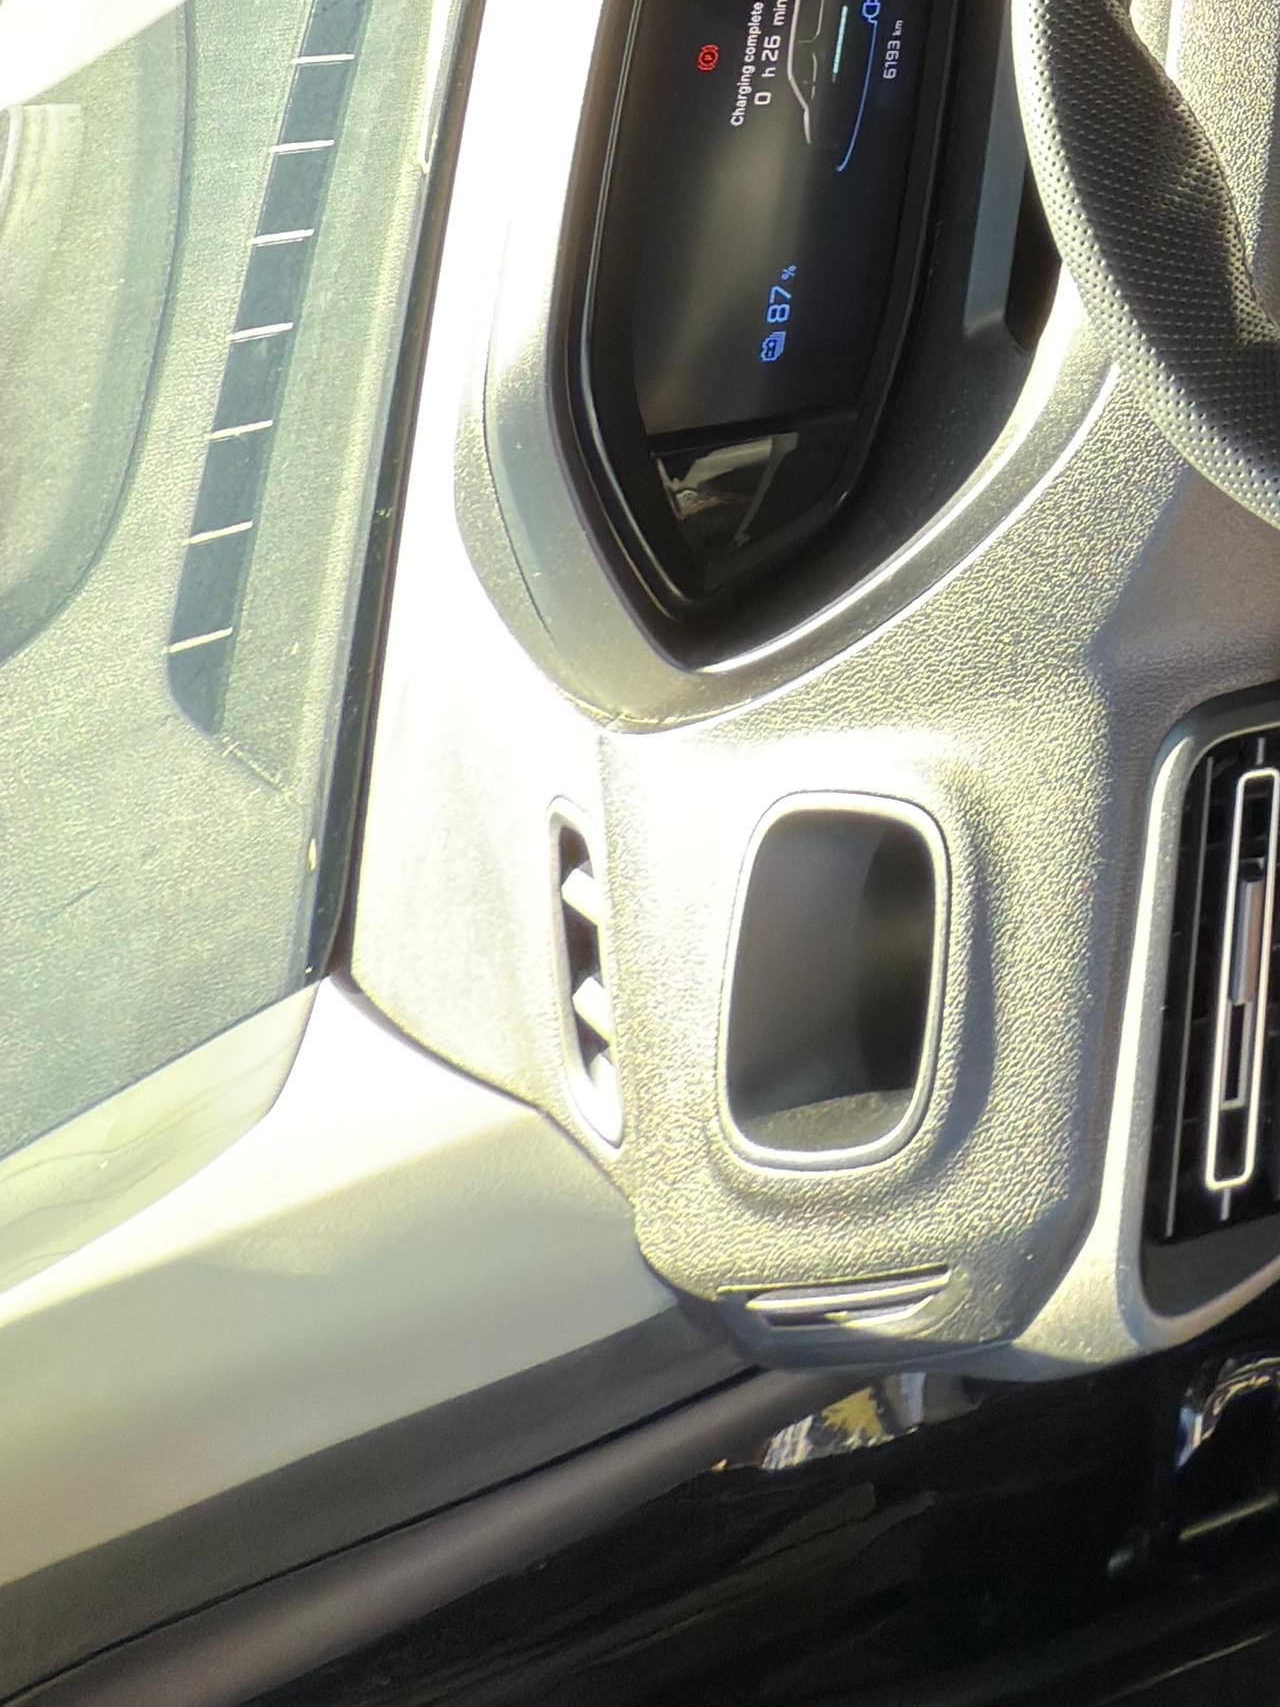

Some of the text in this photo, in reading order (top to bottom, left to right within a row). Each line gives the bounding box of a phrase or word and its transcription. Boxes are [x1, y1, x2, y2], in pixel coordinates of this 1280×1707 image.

[730, 65, 756, 126] Charging
[744, 2, 766, 63] complete
[761, 35, 781, 62] 26
[882, 19, 904, 79] 6193 km
[761, 67, 777, 78] h
[754, 91, 772, 106] 0
[766, 265, 797, 324] 87 %
